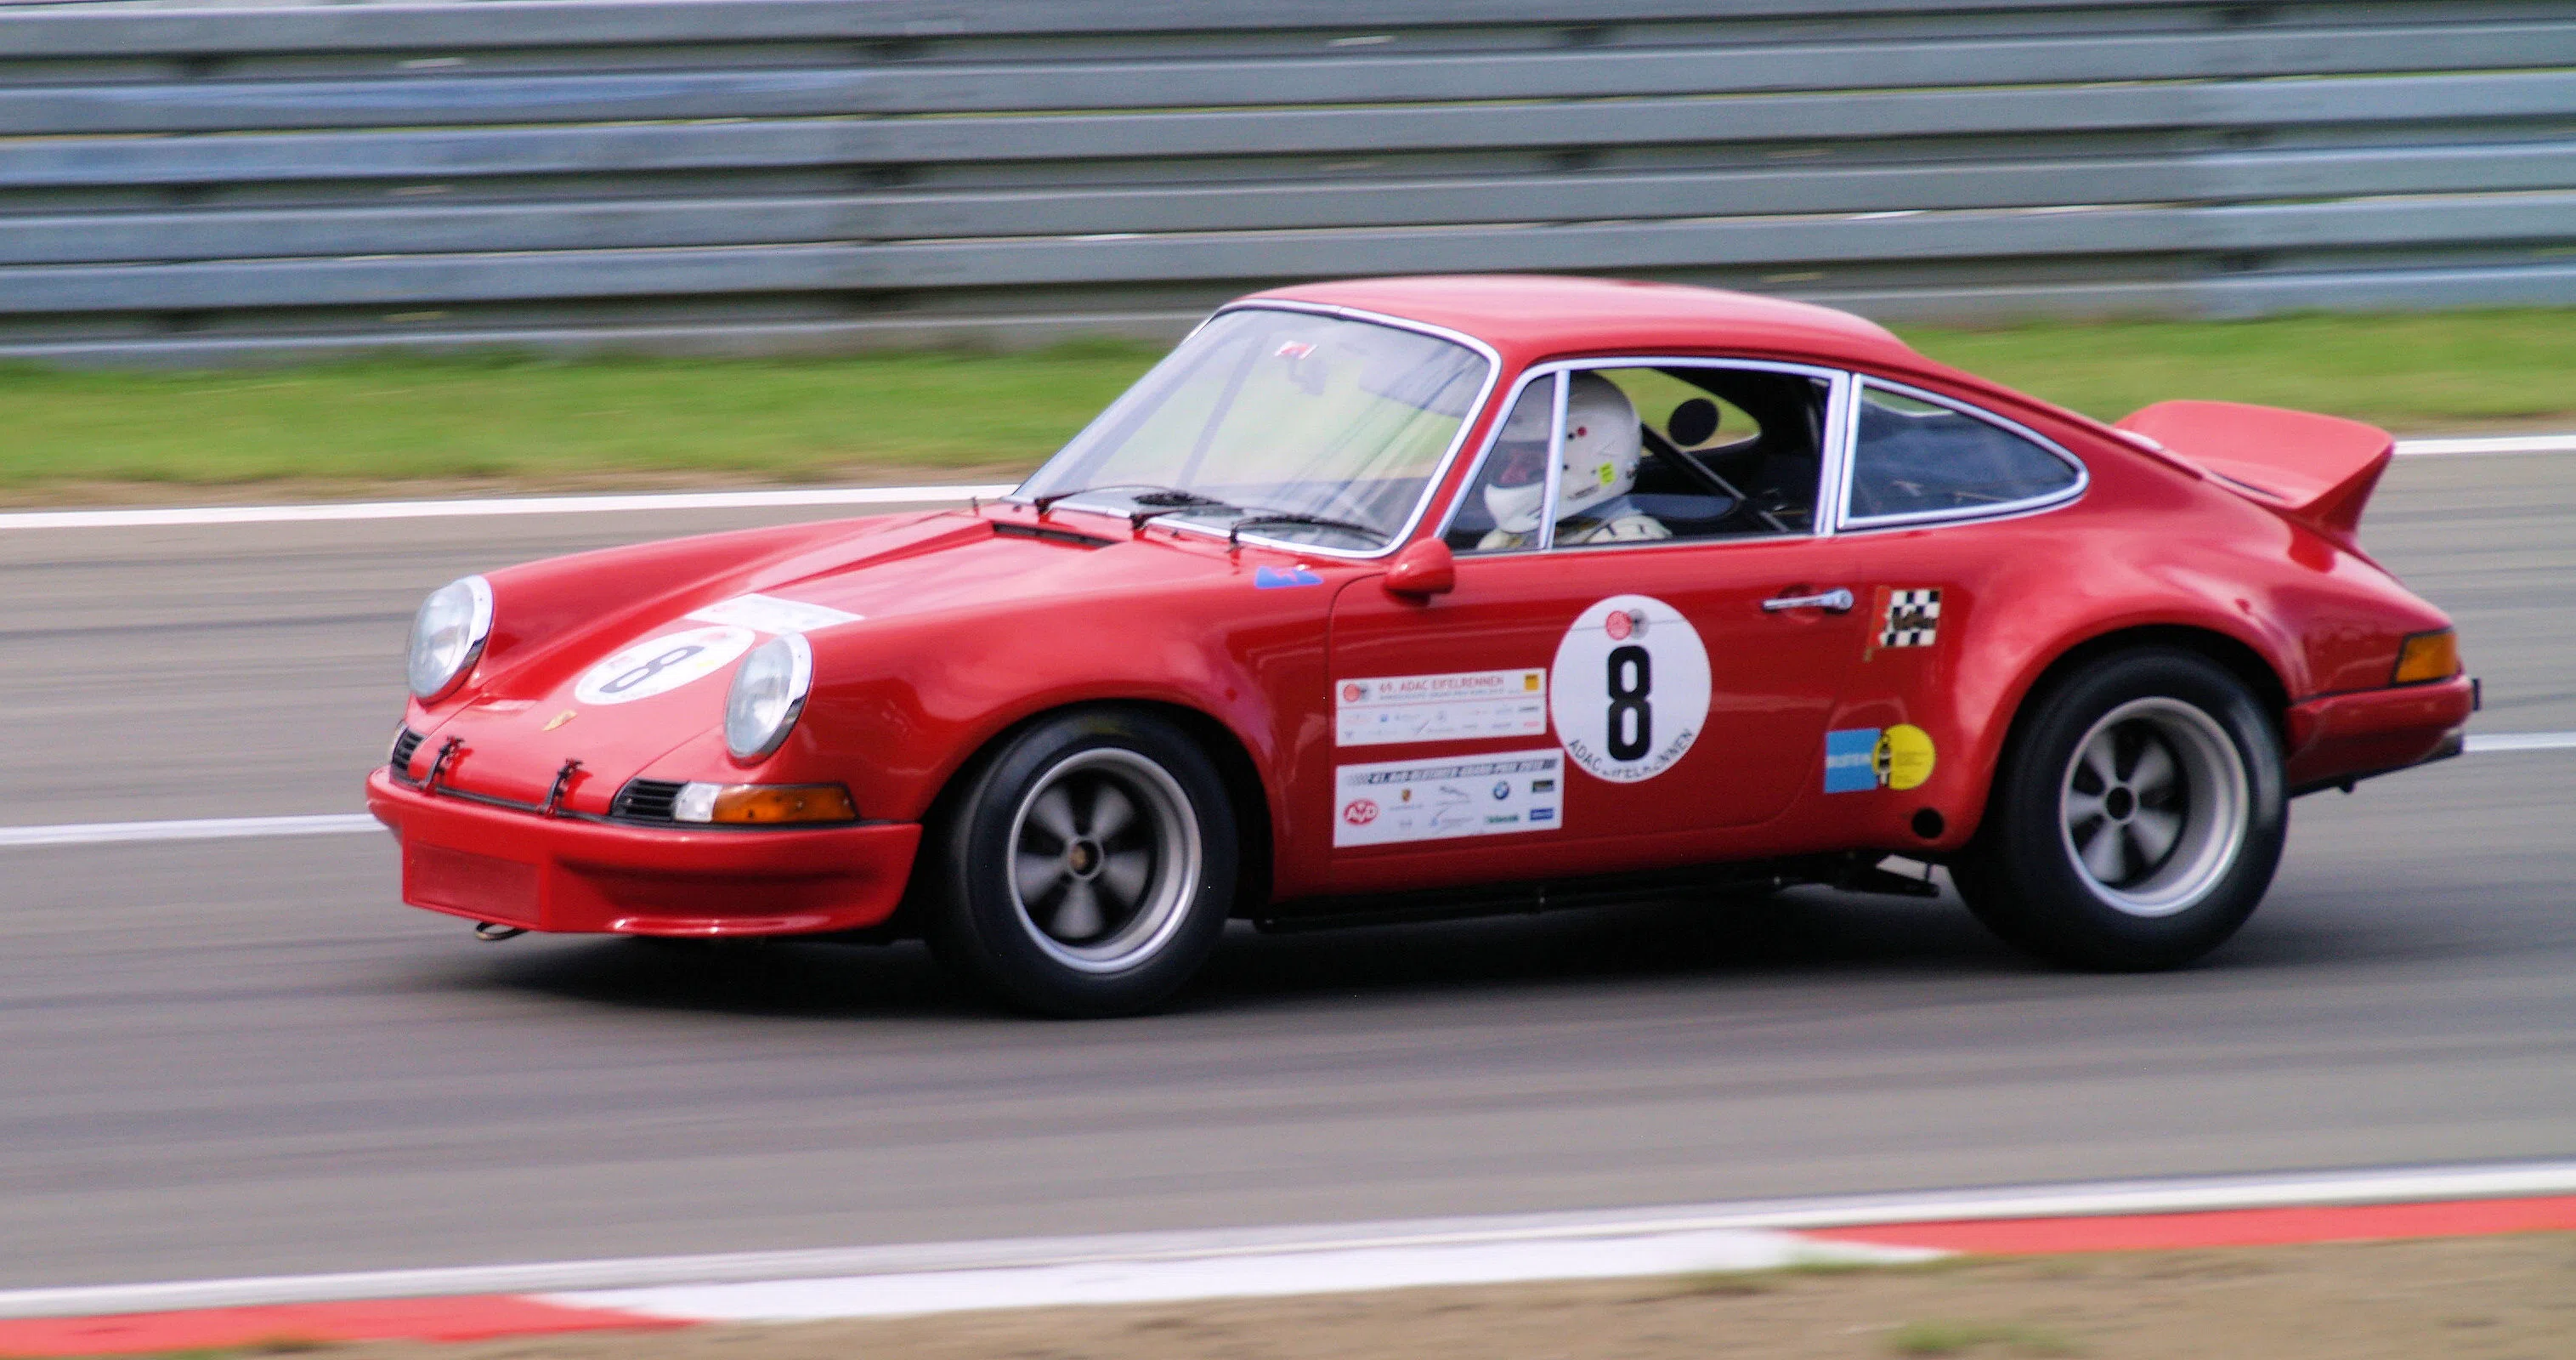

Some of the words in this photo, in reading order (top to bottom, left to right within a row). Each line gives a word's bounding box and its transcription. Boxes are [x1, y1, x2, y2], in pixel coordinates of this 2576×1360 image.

[599, 645, 705, 694] 8
[1400, 678, 1430, 692] ADAC
[1431, 676, 1504, 690] EIFELRENNEN
[1608, 644, 1652, 761] 8
[1569, 739, 1602, 772] ADAC
